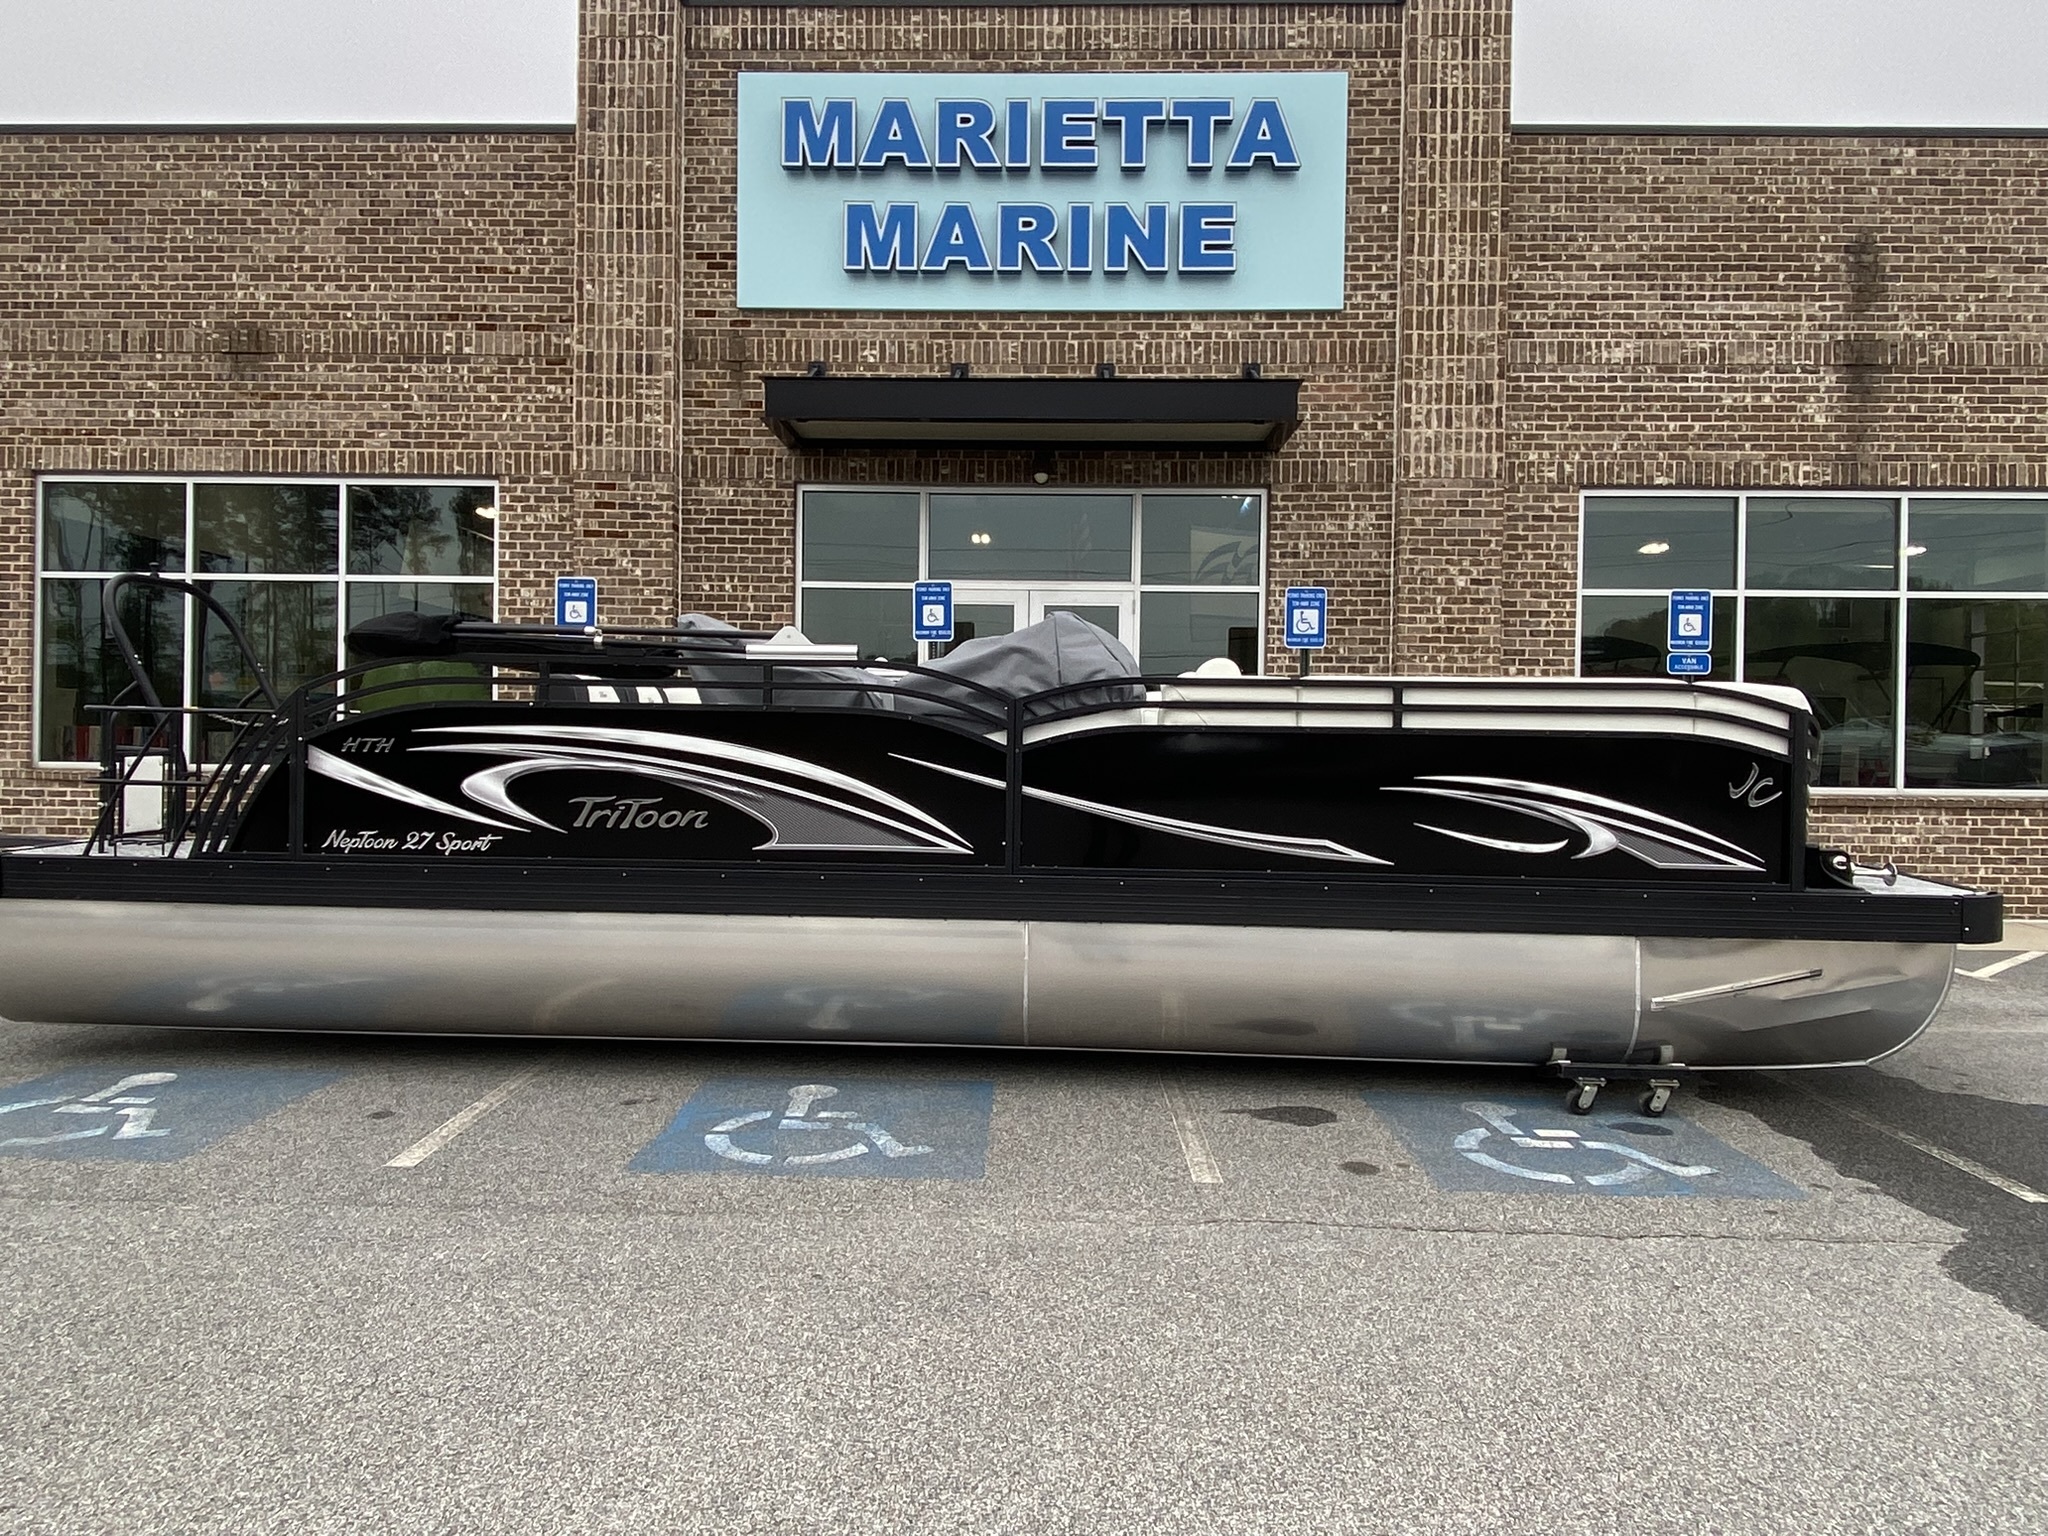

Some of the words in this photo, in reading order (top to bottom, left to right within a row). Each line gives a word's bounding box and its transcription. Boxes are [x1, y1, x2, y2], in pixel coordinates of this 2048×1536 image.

[781, 97, 1300, 171] MARIETTA
[843, 201, 1237, 275] MARINE
[1681, 657, 1697, 665] VAN
[341, 737, 395, 753] HTH
[568, 796, 709, 829] TriToon
[321, 829, 399, 854] NepToon
[401, 831, 435, 850] 27
[435, 832, 503, 856] Sport
